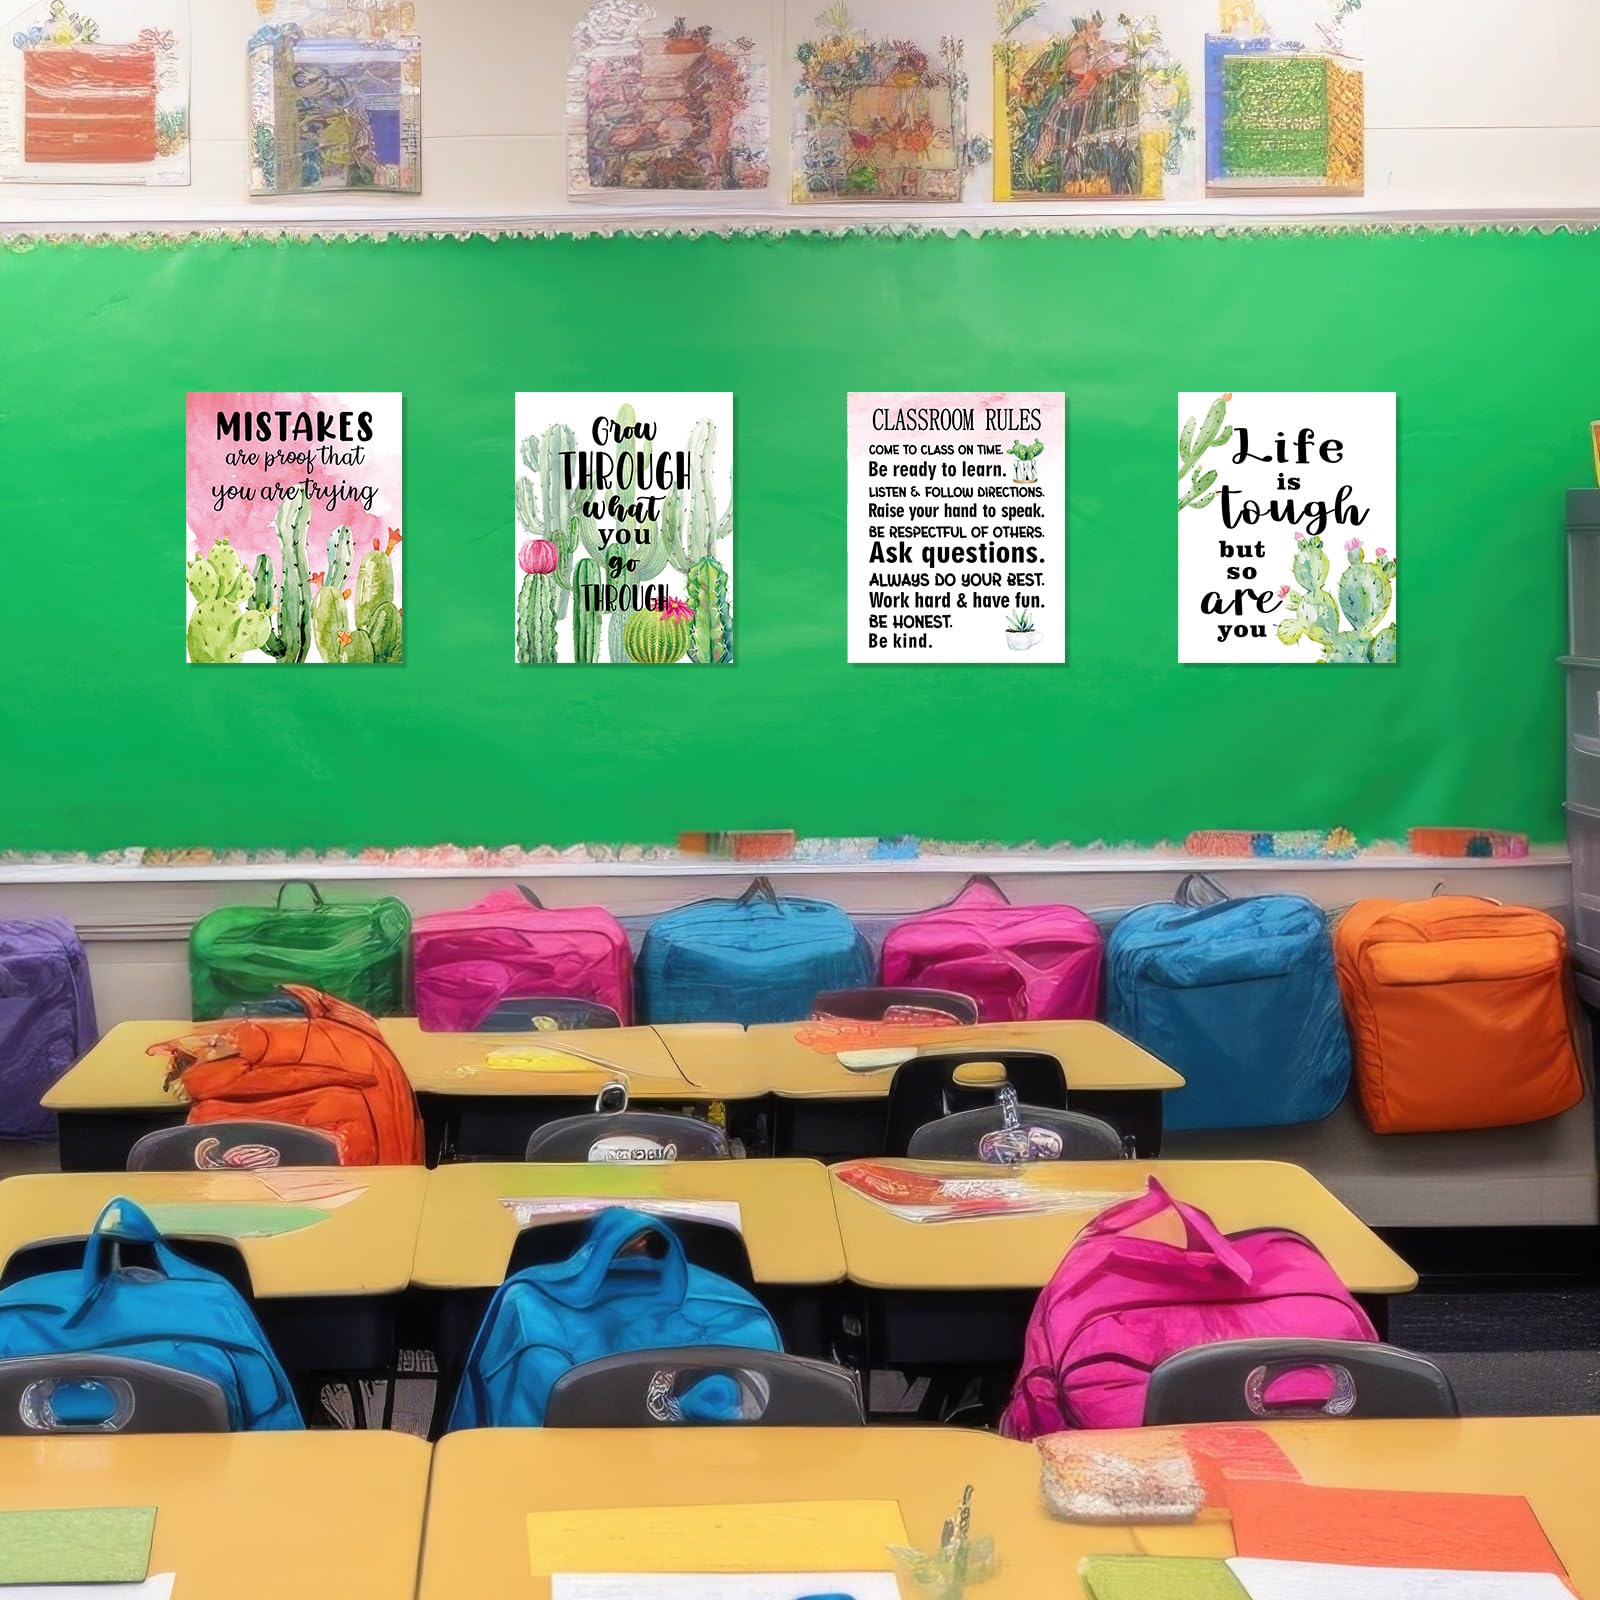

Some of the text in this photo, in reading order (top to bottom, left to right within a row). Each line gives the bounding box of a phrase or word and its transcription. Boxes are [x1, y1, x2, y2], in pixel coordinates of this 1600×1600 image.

[216, 410, 373, 443] MISTAKES
[872, 408, 1042, 431] CLASSROOM RULES
[591, 416, 657, 447] Grow
[868, 444, 1004, 456] COME TO CLASS ON TIME.
[1231, 427, 1344, 465] Life
[225, 445, 365, 475] are proof that
[558, 450, 691, 491] THROUGH
[868, 460, 1007, 481] Be ready to learn.
[868, 485, 1045, 498] LISTEN & FOLLOW DIRECTIONS.
[1276, 472, 1301, 491] is
[211, 477, 379, 512] you are trying
[582, 494, 667, 524] what
[868, 502, 1045, 521] Raise your hand to speak.
[1215, 483, 1371, 536] tough
[597, 528, 651, 553] you
[868, 525, 1045, 539] BE RESPECTFUL OF OTHERS.
[869, 540, 1045, 569] Ask questions.
[1218, 540, 1266, 558] but
[607, 555, 641, 579] go
[1226, 566, 1257, 580] so
[934, 572, 957, 587] DO
[1006, 572, 1045, 587] BEST.
[580, 583, 669, 614] THROUGH
[869, 591, 1045, 609] Work hard & have fun.
[1200, 588, 1284, 616] are
[868, 614, 953, 629] BE HONEST.
[868, 632, 933, 649] Be kind.
[1217, 624, 1267, 643] you
